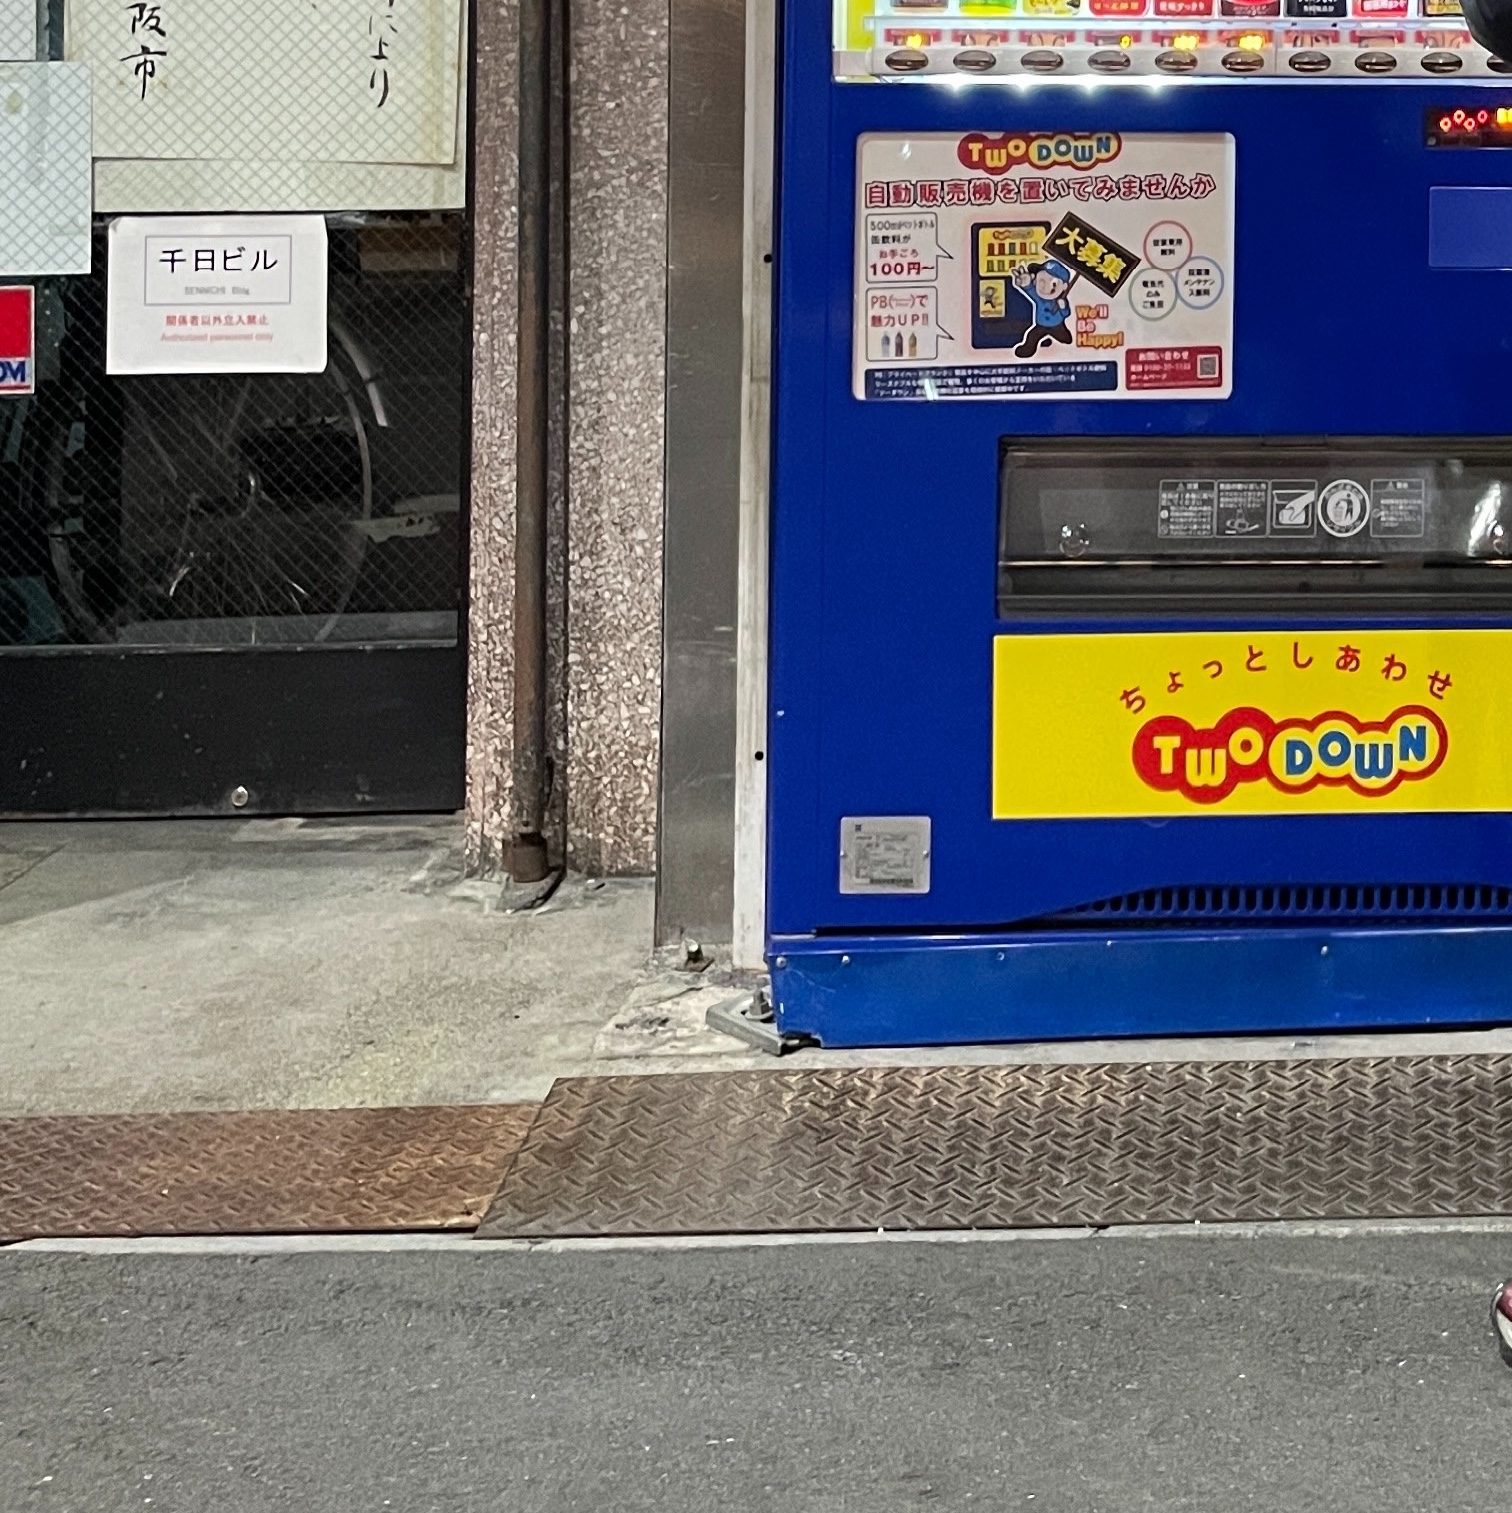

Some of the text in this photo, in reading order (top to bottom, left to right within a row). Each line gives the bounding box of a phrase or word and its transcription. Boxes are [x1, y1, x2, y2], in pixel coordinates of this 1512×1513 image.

[968, 136, 1111, 168] TWO DOWN
[865, 174, 1216, 207] 自動販売機を置いてみませんか
[159, 246, 278, 274] 千日ビル
[1055, 226, 1127, 284] 大募集
[1120, 641, 1452, 714] ちょっとしあわせ
[1153, 724, 1427, 787] TWO DOWN
